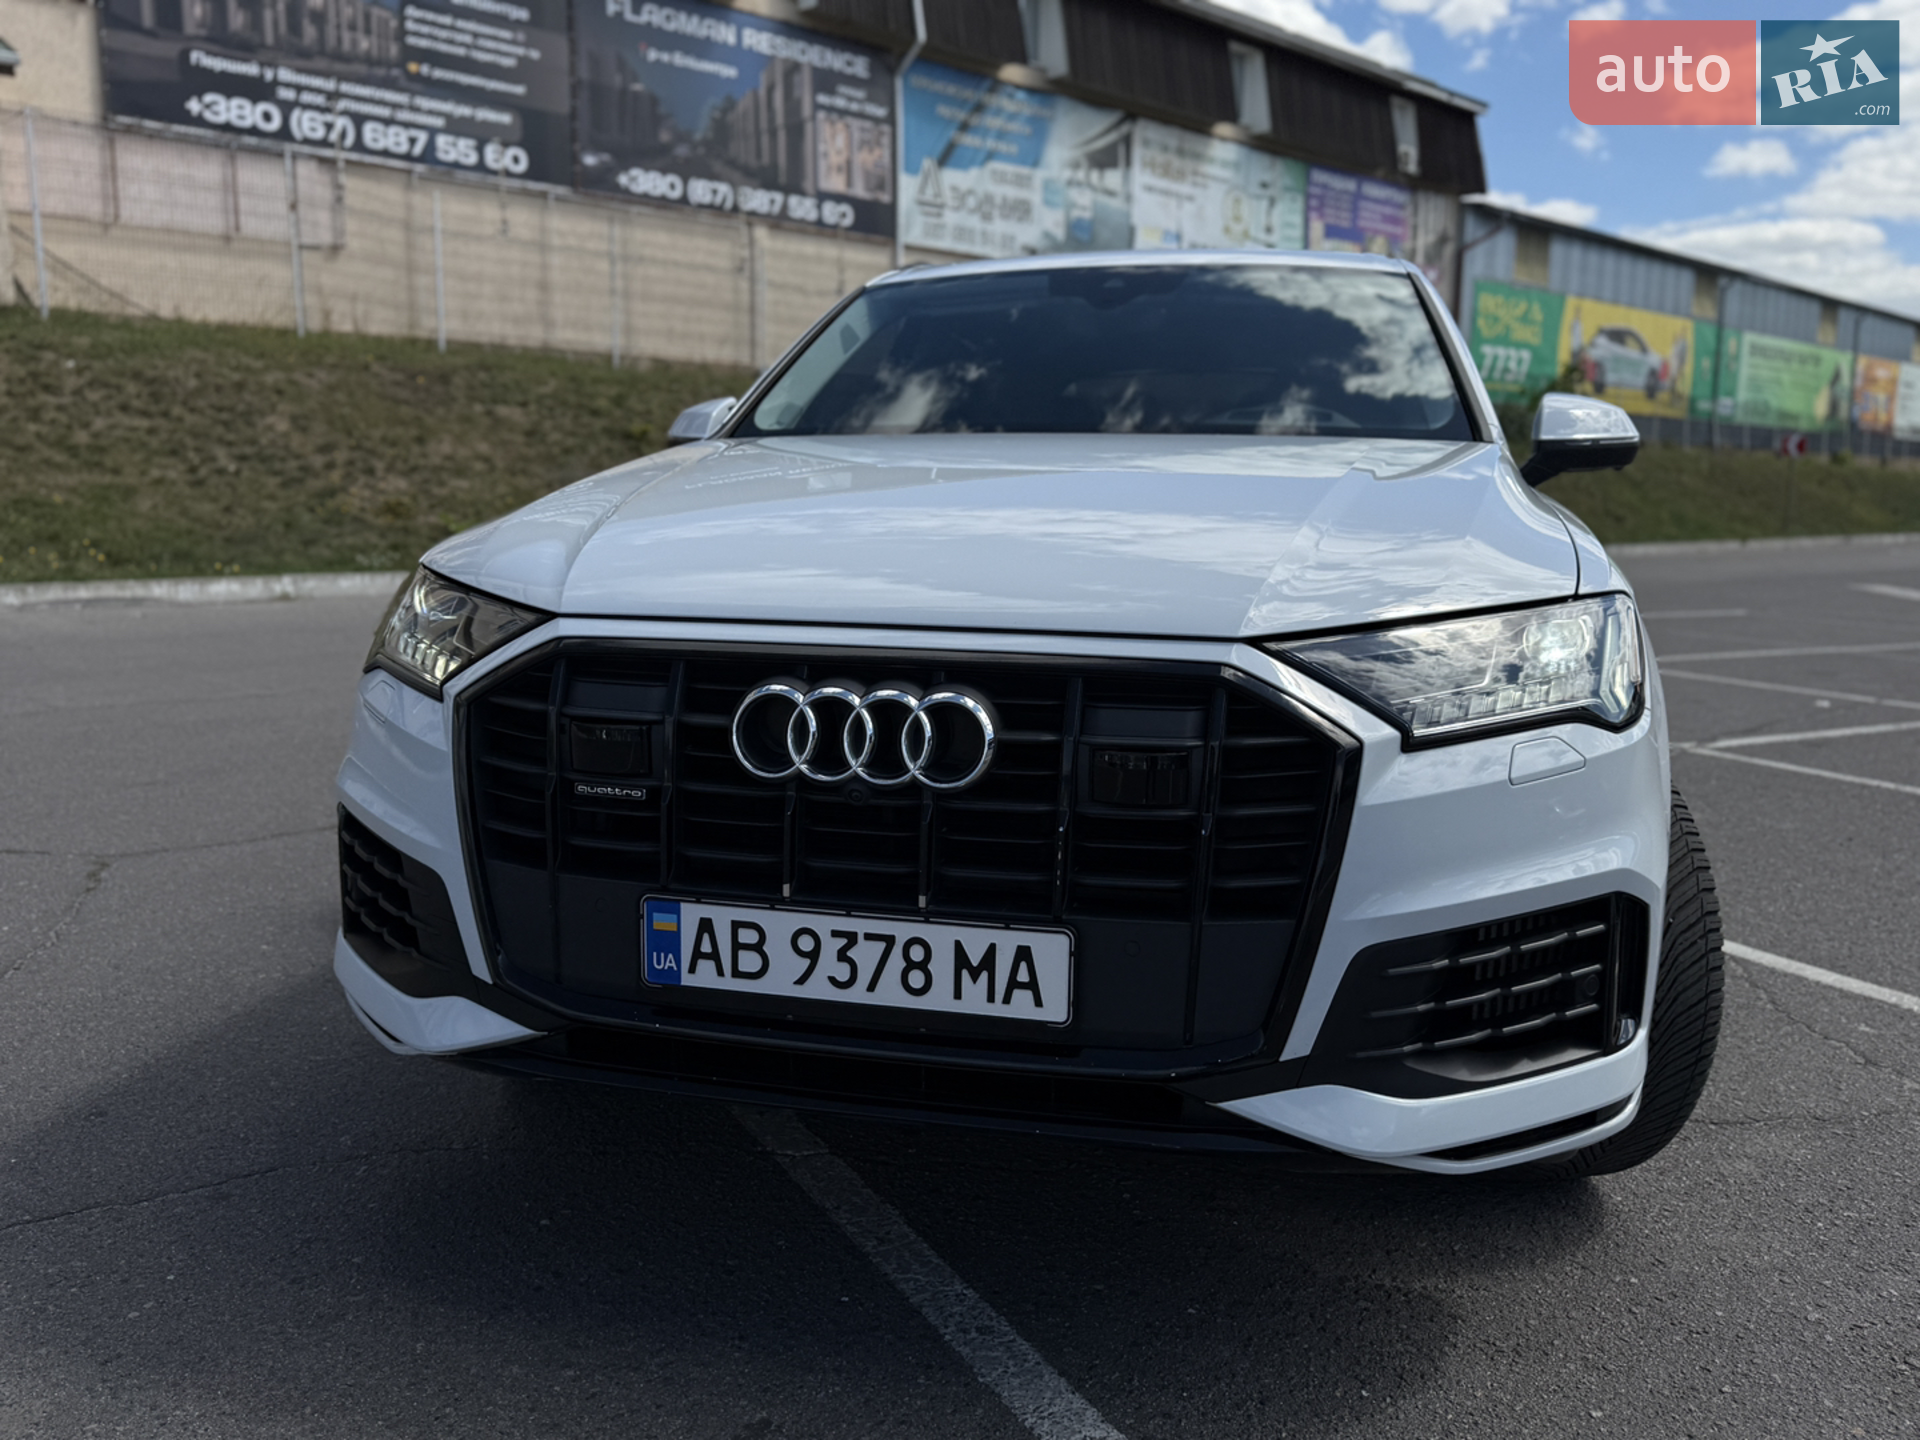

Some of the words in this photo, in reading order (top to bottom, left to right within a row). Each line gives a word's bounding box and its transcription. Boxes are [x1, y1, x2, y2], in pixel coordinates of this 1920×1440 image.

[606, 0, 737, 46] FLAGMAN
[741, 27, 871, 79] RESIDENCE
[189, 50, 261, 77] Перший
[184, 92, 282, 133] +380
[289, 107, 356, 149] (67)
[361, 120, 429, 157] 687
[434, 133, 479, 166] 55
[484, 142, 529, 174] 60
[617, 168, 684, 200] +380
[787, 194, 819, 222] 55
[1481, 345, 1532, 382] 7737
[577, 785, 641, 797] quattro
[652, 951, 678, 971] UA
[688, 916, 770, 980] AB
[790, 926, 933, 997] 9378
[953, 939, 1044, 1008] MA
